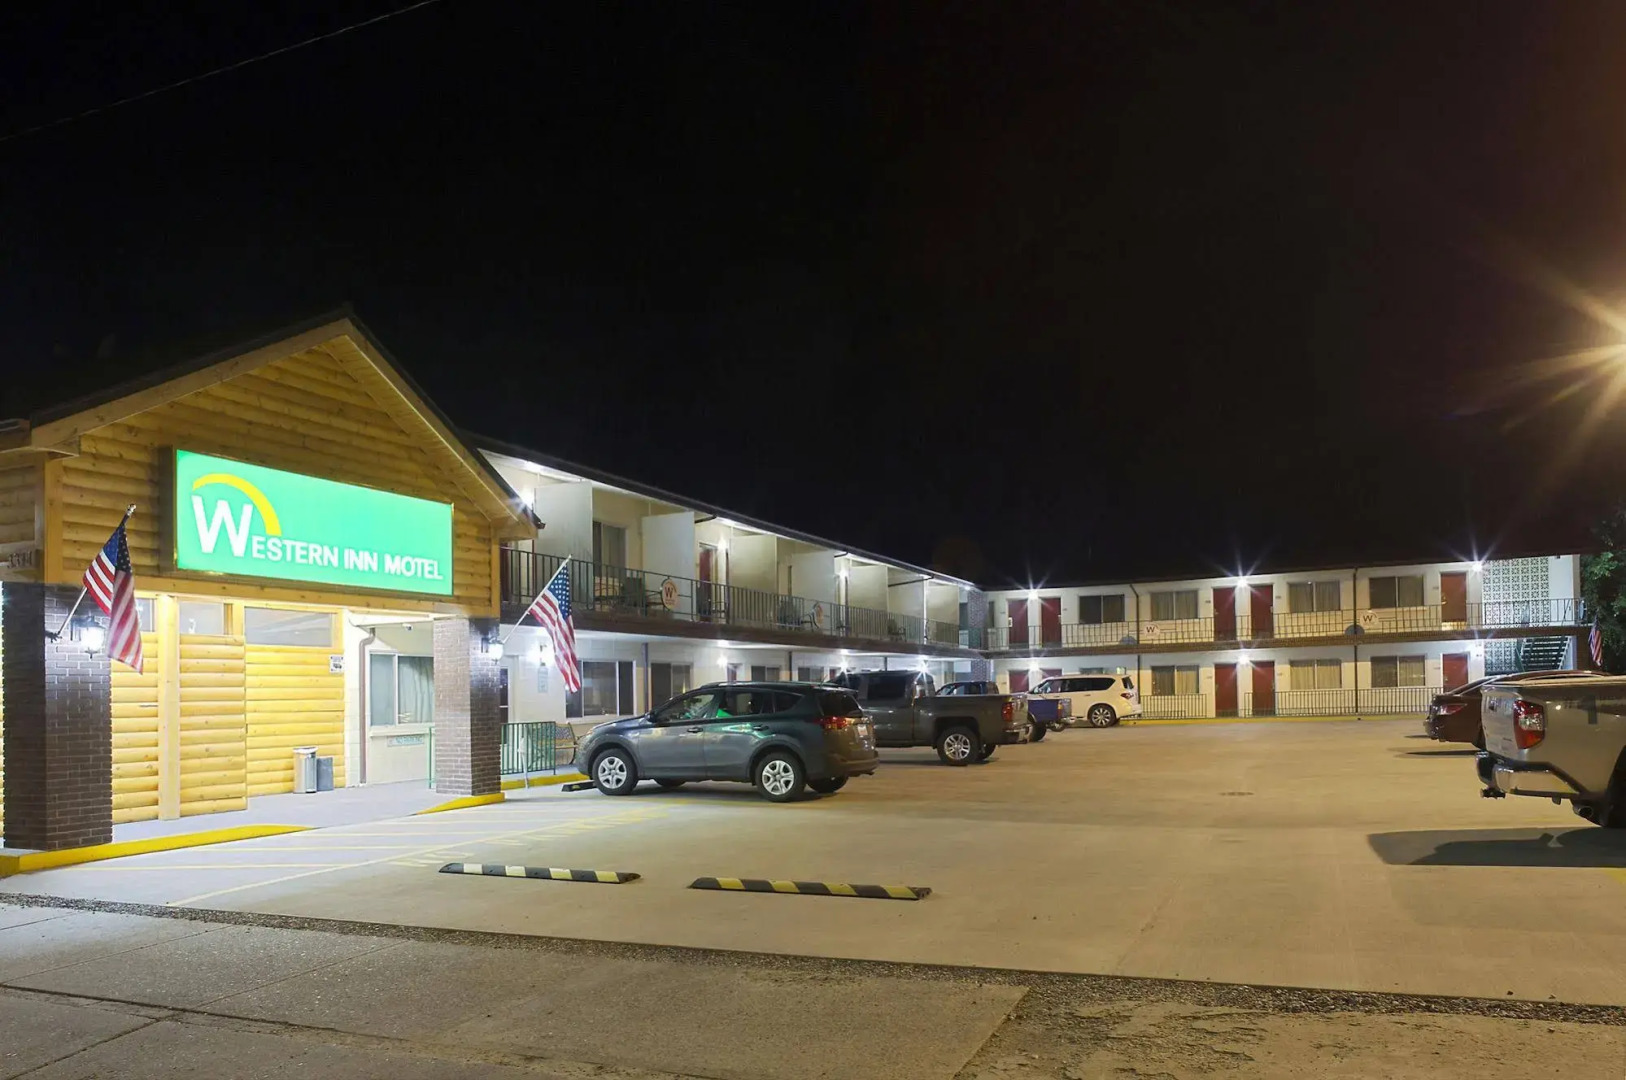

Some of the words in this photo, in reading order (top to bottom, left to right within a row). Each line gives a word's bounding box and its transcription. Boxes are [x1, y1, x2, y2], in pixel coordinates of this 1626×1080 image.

[191, 494, 339, 568] WESTERN
[343, 547, 378, 573] INN
[384, 553, 443, 580] MOTEL
[1363, 614, 1373, 622] W
[1146, 625, 1155, 633] W
